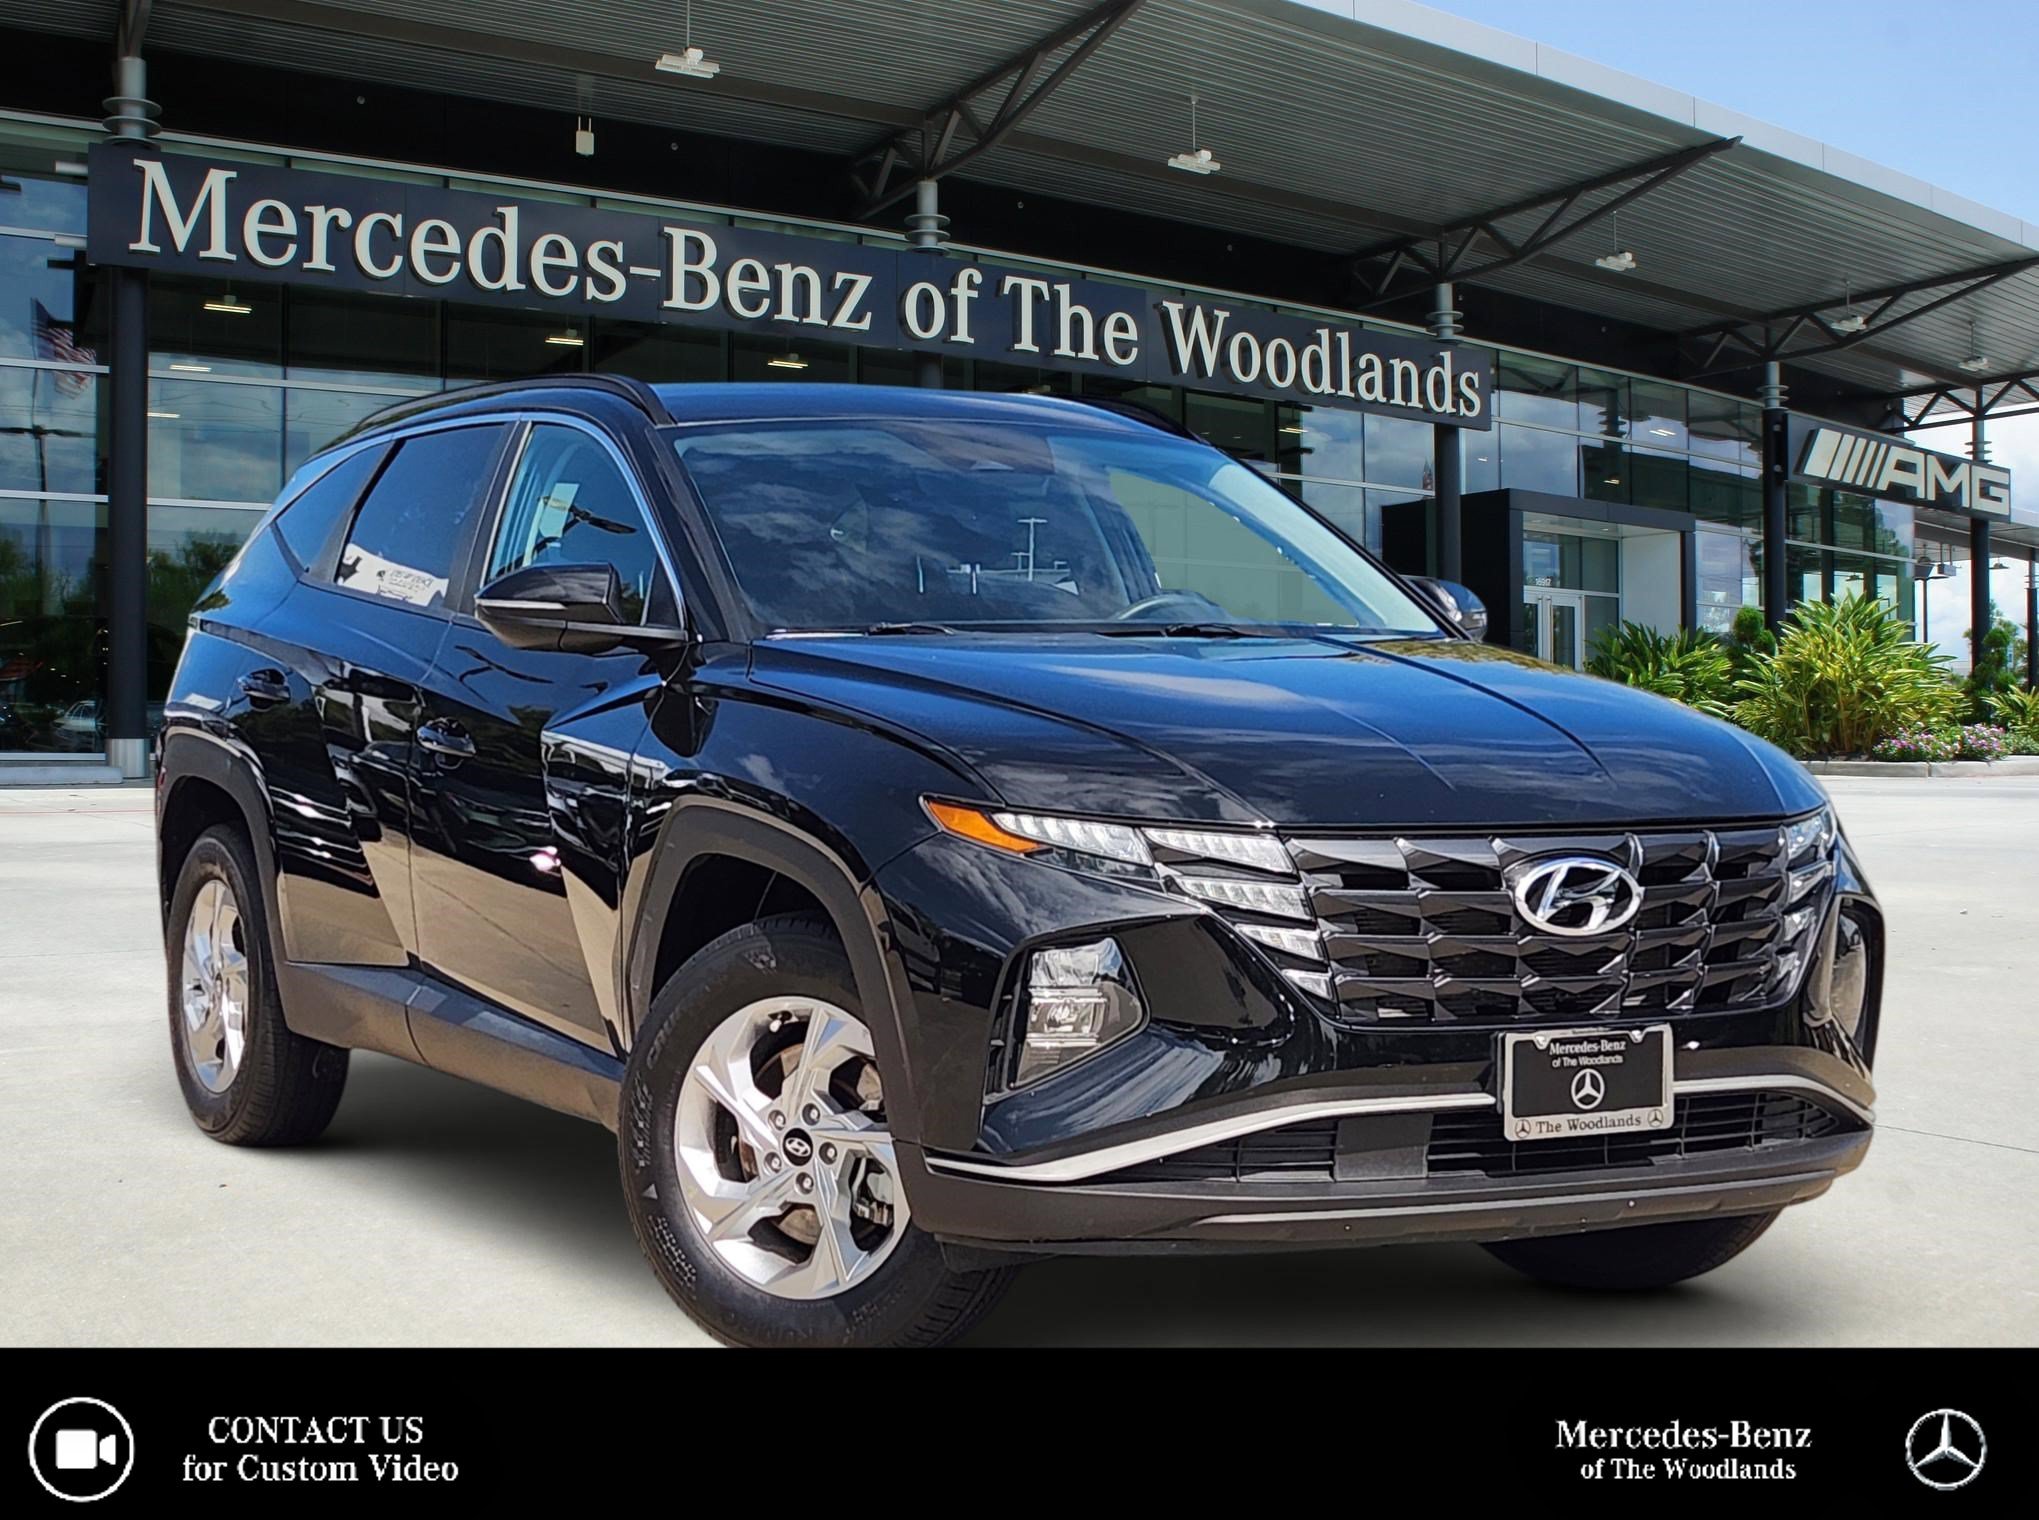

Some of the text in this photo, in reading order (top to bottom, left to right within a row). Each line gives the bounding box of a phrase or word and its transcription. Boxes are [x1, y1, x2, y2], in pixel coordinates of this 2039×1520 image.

[128, 158, 1481, 418] Mercedes-Benz of The Woodlands
[1876, 445, 2010, 516] AMG
[1549, 1040, 1626, 1055] Mercedes-Benz
[1552, 1055, 1623, 1068] of The Woodlands
[1536, 1114, 1642, 1134] The Woodlands
